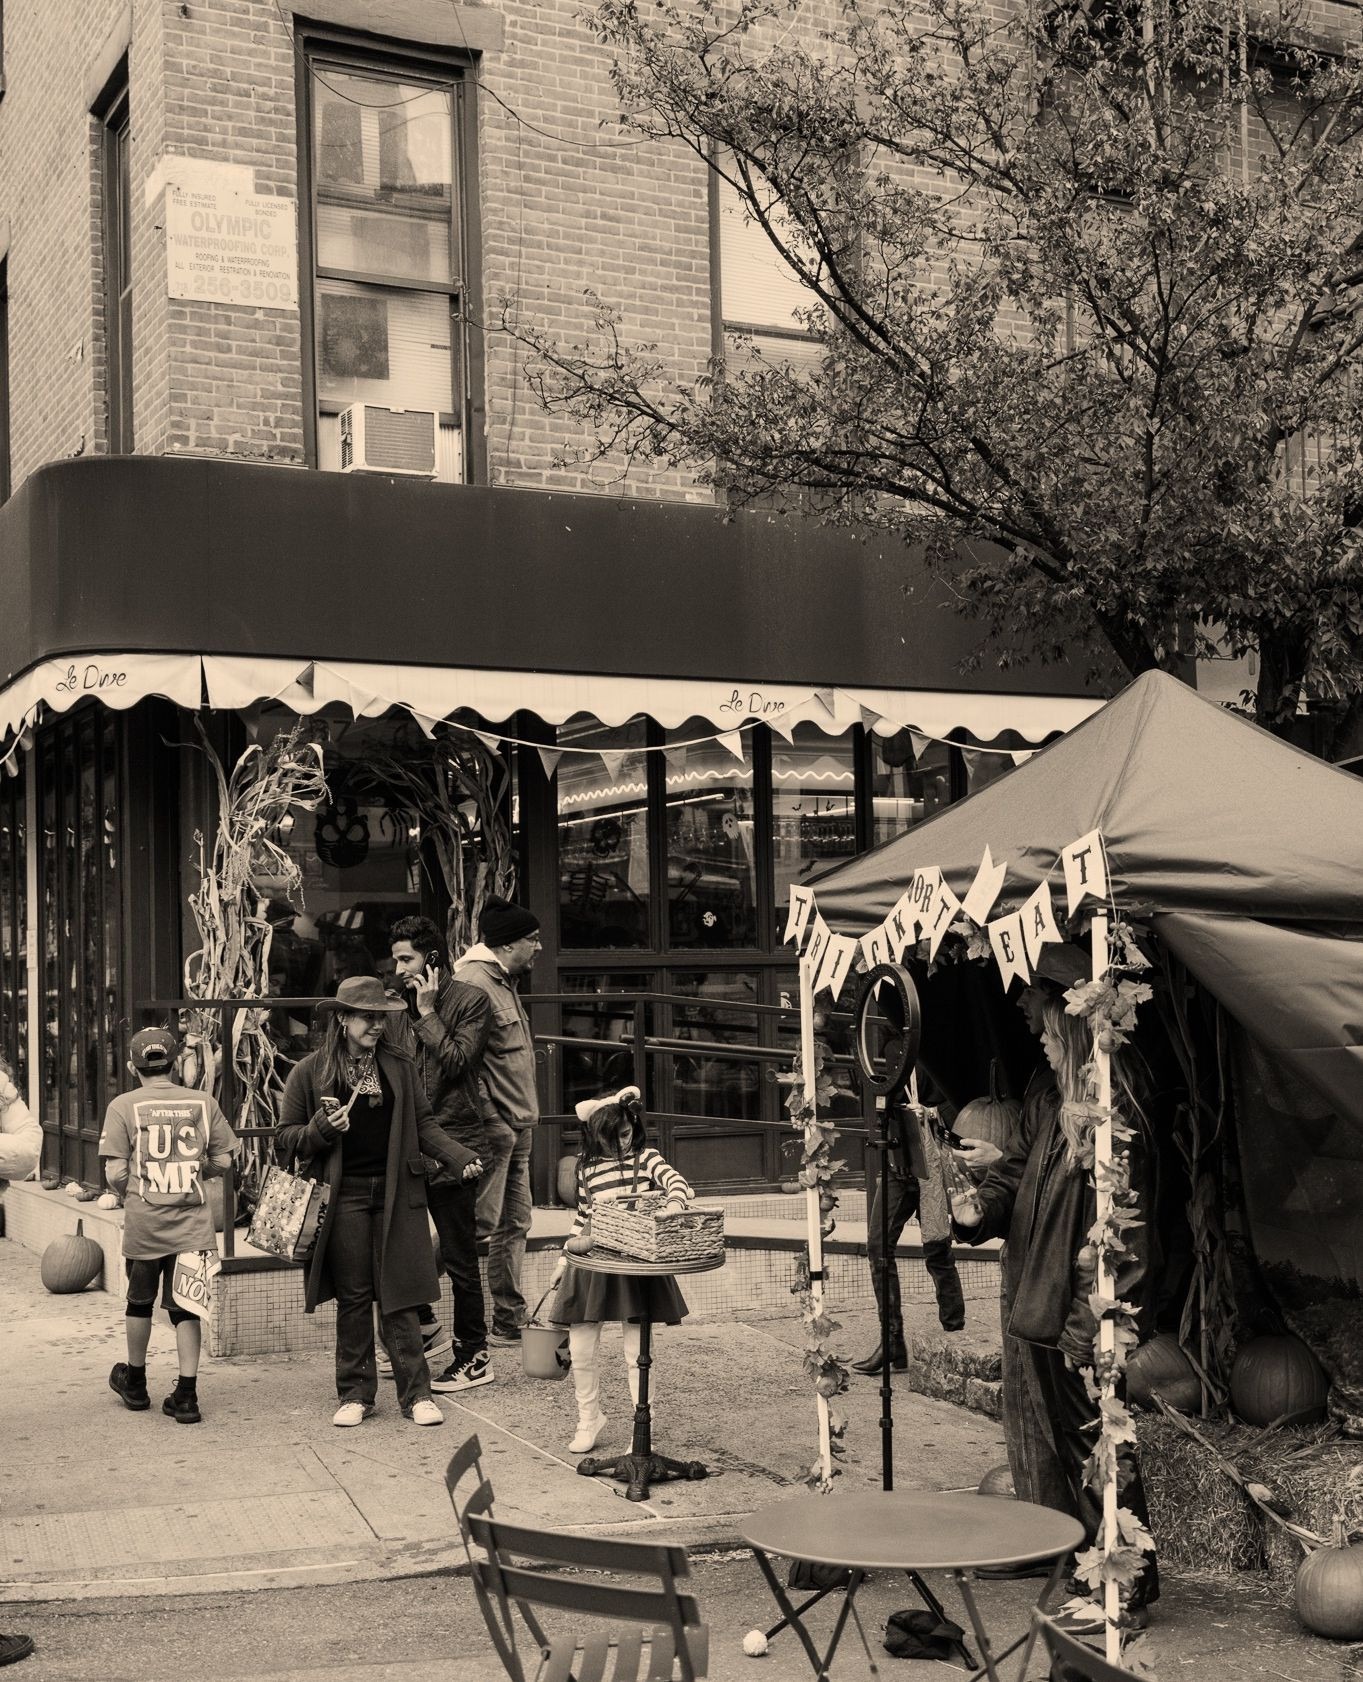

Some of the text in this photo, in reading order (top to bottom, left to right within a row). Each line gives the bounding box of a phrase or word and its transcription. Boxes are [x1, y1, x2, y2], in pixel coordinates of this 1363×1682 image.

[172, 198, 187, 207] FREE
[191, 210, 272, 240] OLYMPIC
[172, 233, 290, 258] WATERPROOFING CORP.
[175, 261, 184, 270] ALL
[189, 262, 215, 272] EXTERIOR
[259, 270, 291, 280] RENOVATION
[195, 252, 218, 263] ROOFING
[227, 256, 270, 268] WATERPROOFING
[193, 274, 291, 302] 256-3509
[55, 664, 79, 693] Le
[719, 689, 744, 713] Le
[933, 845, 1093, 964] TEAT
